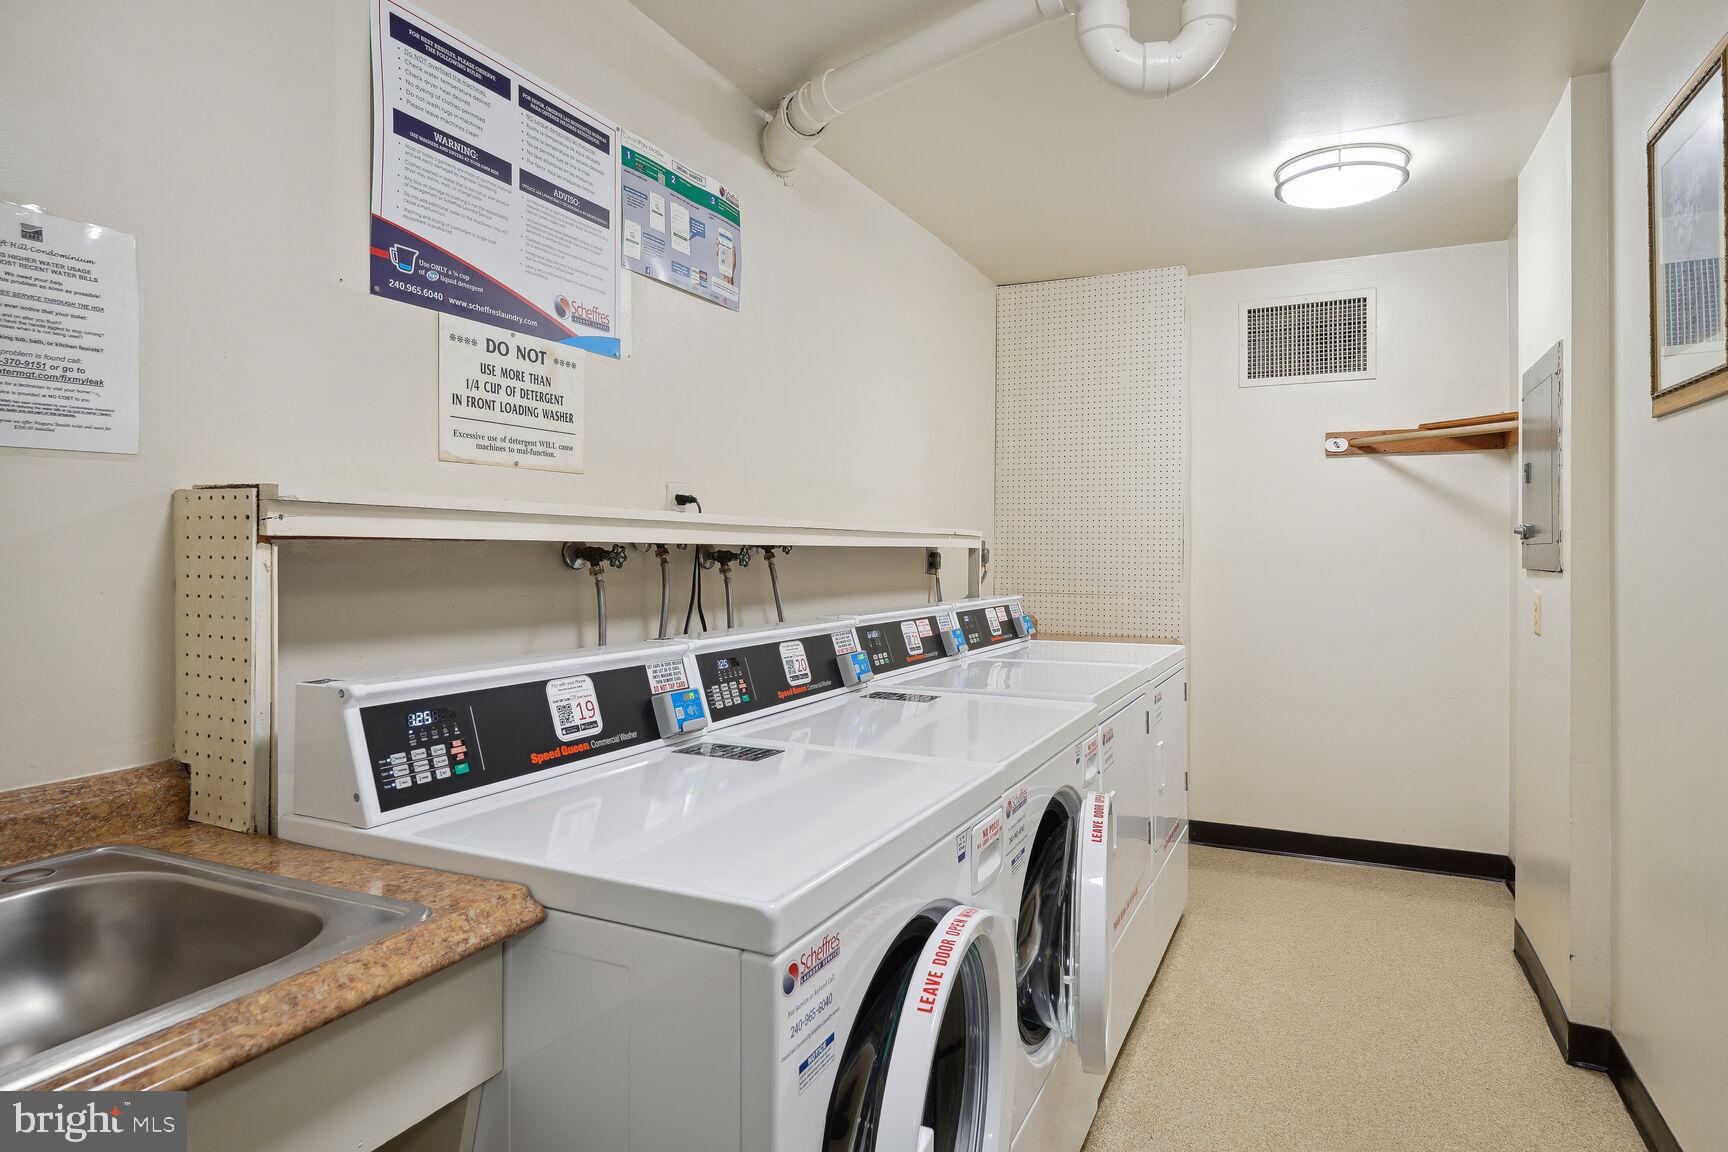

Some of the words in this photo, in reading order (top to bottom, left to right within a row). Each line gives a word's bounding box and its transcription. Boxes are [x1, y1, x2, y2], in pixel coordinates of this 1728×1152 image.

[424, 43, 435, 54] THE
[404, 58, 422, 72] Check
[423, 68, 439, 81] water
[440, 77, 471, 99] temperature
[472, 94, 490, 107] desired
[405, 68, 423, 82] Check
[424, 78, 438, 91] dryer
[439, 86, 451, 97] heat
[451, 92, 470, 106] desired
[405, 88, 414, 98] Do
[415, 93, 425, 103] not
[426, 98, 440, 110] wash
[441, 107, 452, 117] rugs
[460, 115, 483, 132] machines
[406, 98, 424, 112] Please
[425, 108, 439, 119] leave
[440, 115, 465, 132] machines
[465, 128, 479, 138] clean
[441, 96, 460, 111] clothes
[461, 107, 485, 124] permitted
[433, 131, 478, 160] WARNING:
[626, 150, 630, 160] 1
[7, 253, 39, 264] HIGHER
[39, 259, 65, 270] WATER
[66, 265, 91, 275] USAGE
[10, 240, 28, 251] Hill
[30, 245, 95, 265] Condominium
[18, 262, 49, 273] RECENT
[50, 268, 77, 279] WATER
[78, 274, 98, 283] BILLS
[419, 260, 429, 268] Use
[431, 263, 447, 273] ONLY
[459, 273, 470, 281] cup
[10, 278, 37, 288] problem
[440, 275, 457, 285] liquid
[458, 281, 484, 293] detergent
[12, 291, 41, 301] SERVICE
[43, 297, 75, 307] THROUGH
[77, 302, 89, 310] THE
[90, 305, 104, 313] HOA
[389, 280, 443, 300] 240.965.6040
[448, 298, 538, 327] www.scheffreslaundry.com
[571, 300, 609, 325] Scheffres
[0, 348, 32, 358] problem
[43, 353, 65, 362] found
[485, 336, 509, 357] DO
[516, 344, 546, 366] NOT
[61, 365, 74, 374] go
[480, 362, 496, 376] USE
[500, 366, 525, 382] MORE
[529, 372, 551, 387] THAN
[465, 377, 479, 392] 1/4
[484, 380, 501, 395] CUP
[505, 384, 516, 397] OF
[519, 386, 563, 406] DETERGENT
[452, 392, 461, 406] IN
[466, 395, 495, 411] FRONT
[499, 400, 538, 418] LOADING
[541, 407, 573, 424] WASHER
[453, 428, 484, 440] Excessive
[487, 434, 497, 442] use
[508, 436, 536, 447] detergent
[538, 440, 556, 449] WILL
[475, 442, 506, 452] machines
[516, 447, 555, 458] mal-function.
[795, 659, 807, 672] 20
[675, 680, 685, 688] CARD
[778, 689, 792, 699] Speed
[576, 700, 596, 721] 19
[530, 751, 561, 764] Speed
[562, 743, 589, 756] Queen
[590, 736, 620, 749] Commercial
[620, 730, 637, 742] Washer
[1094, 805, 1104, 819] DOOR
[1092, 820, 1104, 843] LEAVE
[800, 932, 840, 975] Scheffres
[917, 971, 944, 1014] LEAVE
[932, 939, 956, 966] DOOR
[946, 919, 965, 936] OPEN
[790, 993, 833, 1039] 240-965-6040
